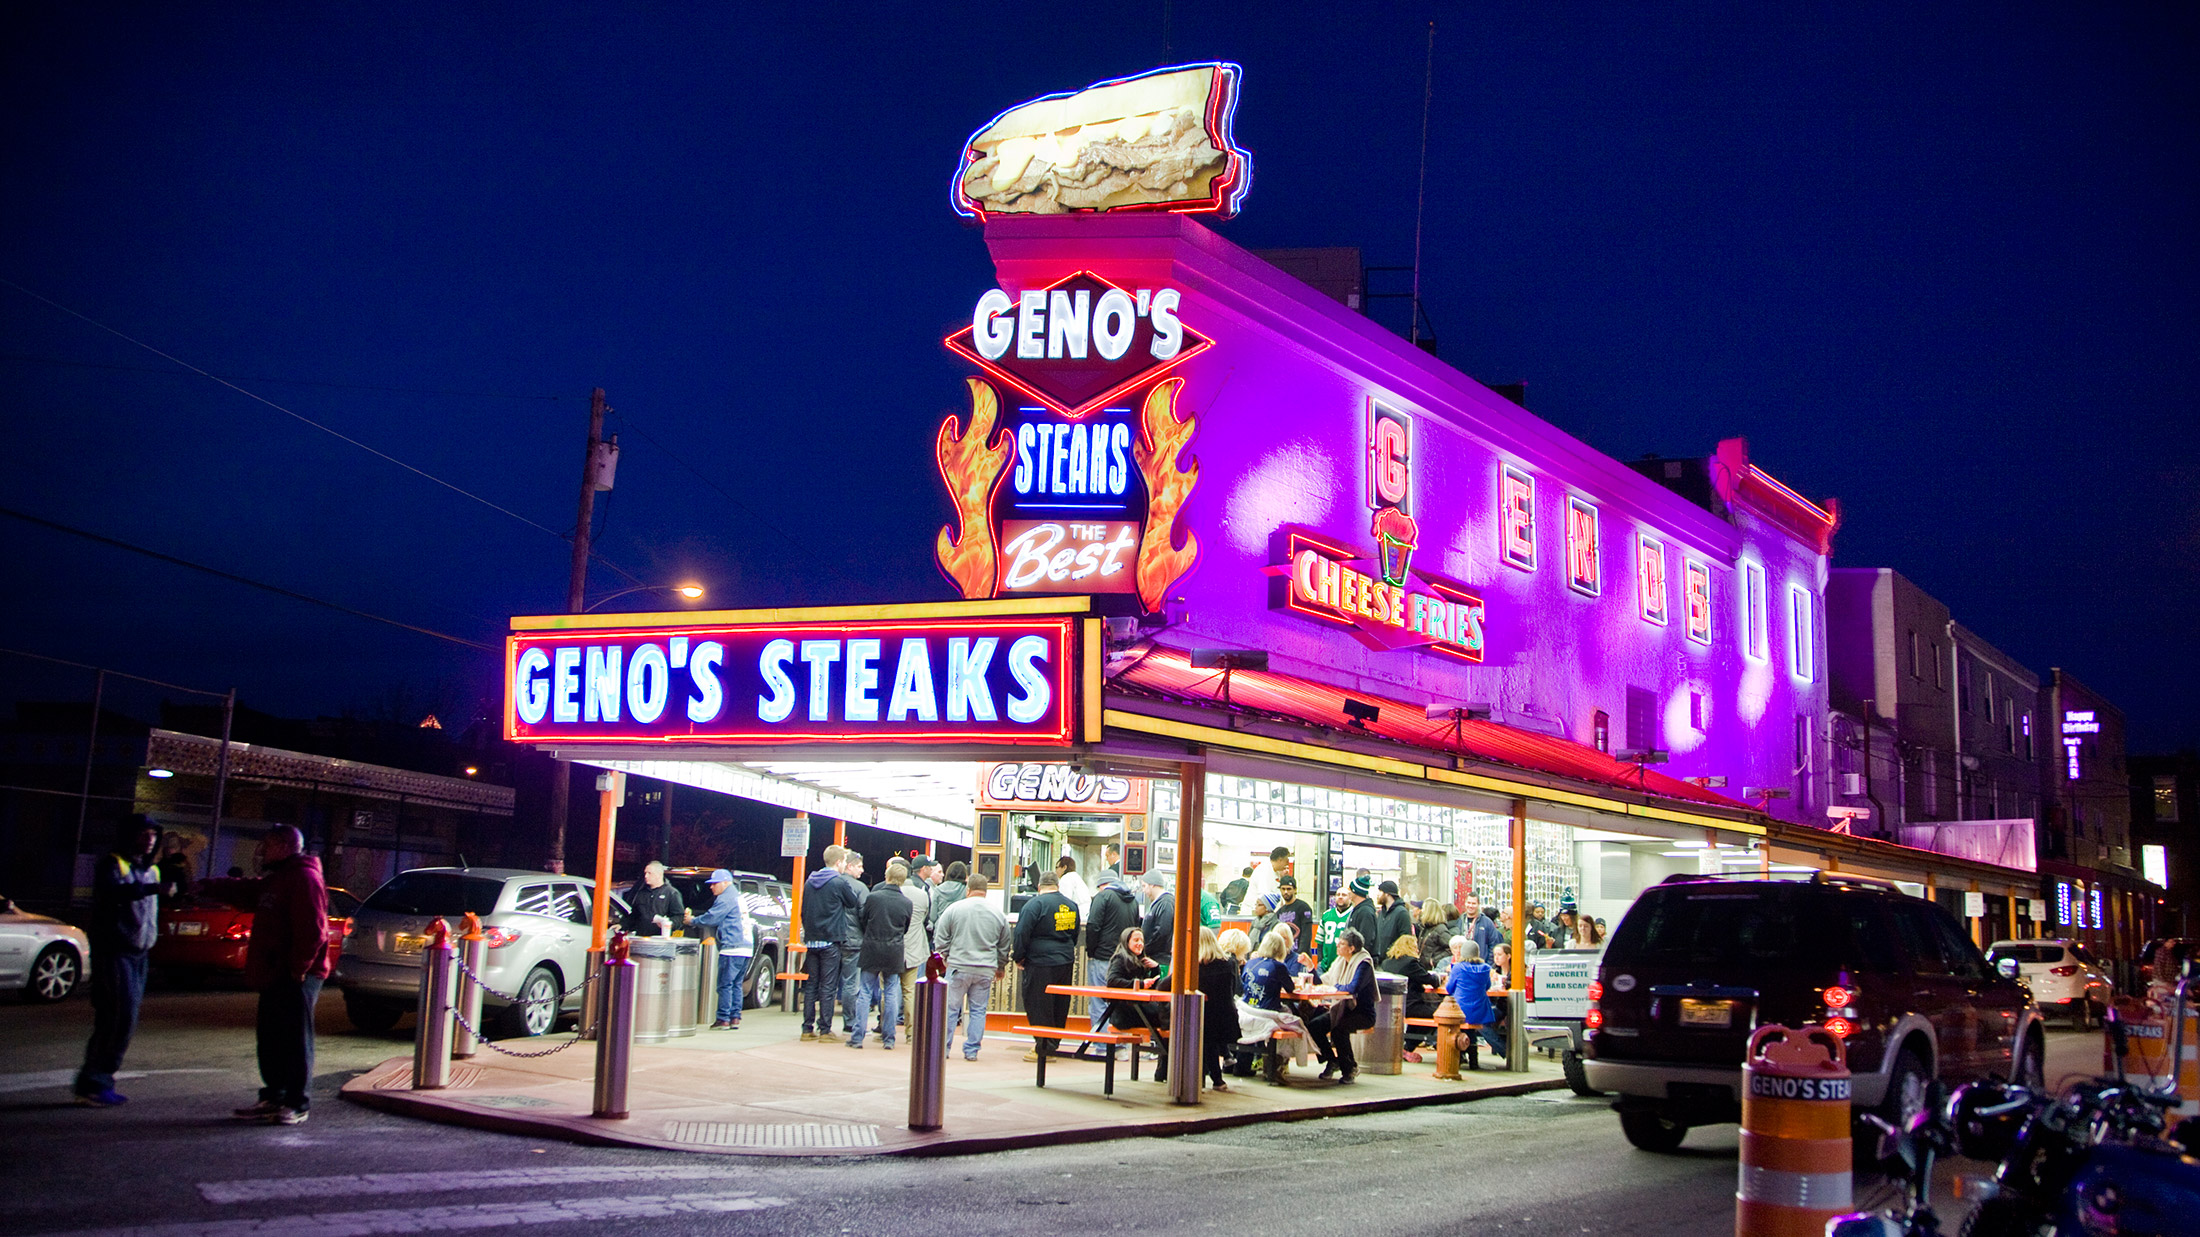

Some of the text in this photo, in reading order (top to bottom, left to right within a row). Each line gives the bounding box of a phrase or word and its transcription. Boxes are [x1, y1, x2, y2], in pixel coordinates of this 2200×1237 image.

[973, 288, 1183, 360] GENO'S
[1014, 422, 1130, 495] STEAKS
[1004, 522, 1135, 590] Best
[1069, 524, 1107, 541] THE
[1293, 550, 1405, 628] CHEESE
[1408, 593, 1484, 650] FRIES
[516, 634, 1053, 724] GENO'S STEAKS
[988, 763, 1130, 803] GENO'S
[1548, 970, 1589, 978] CONCRETE
[1752, 1075, 1815, 1099] GENO'S
